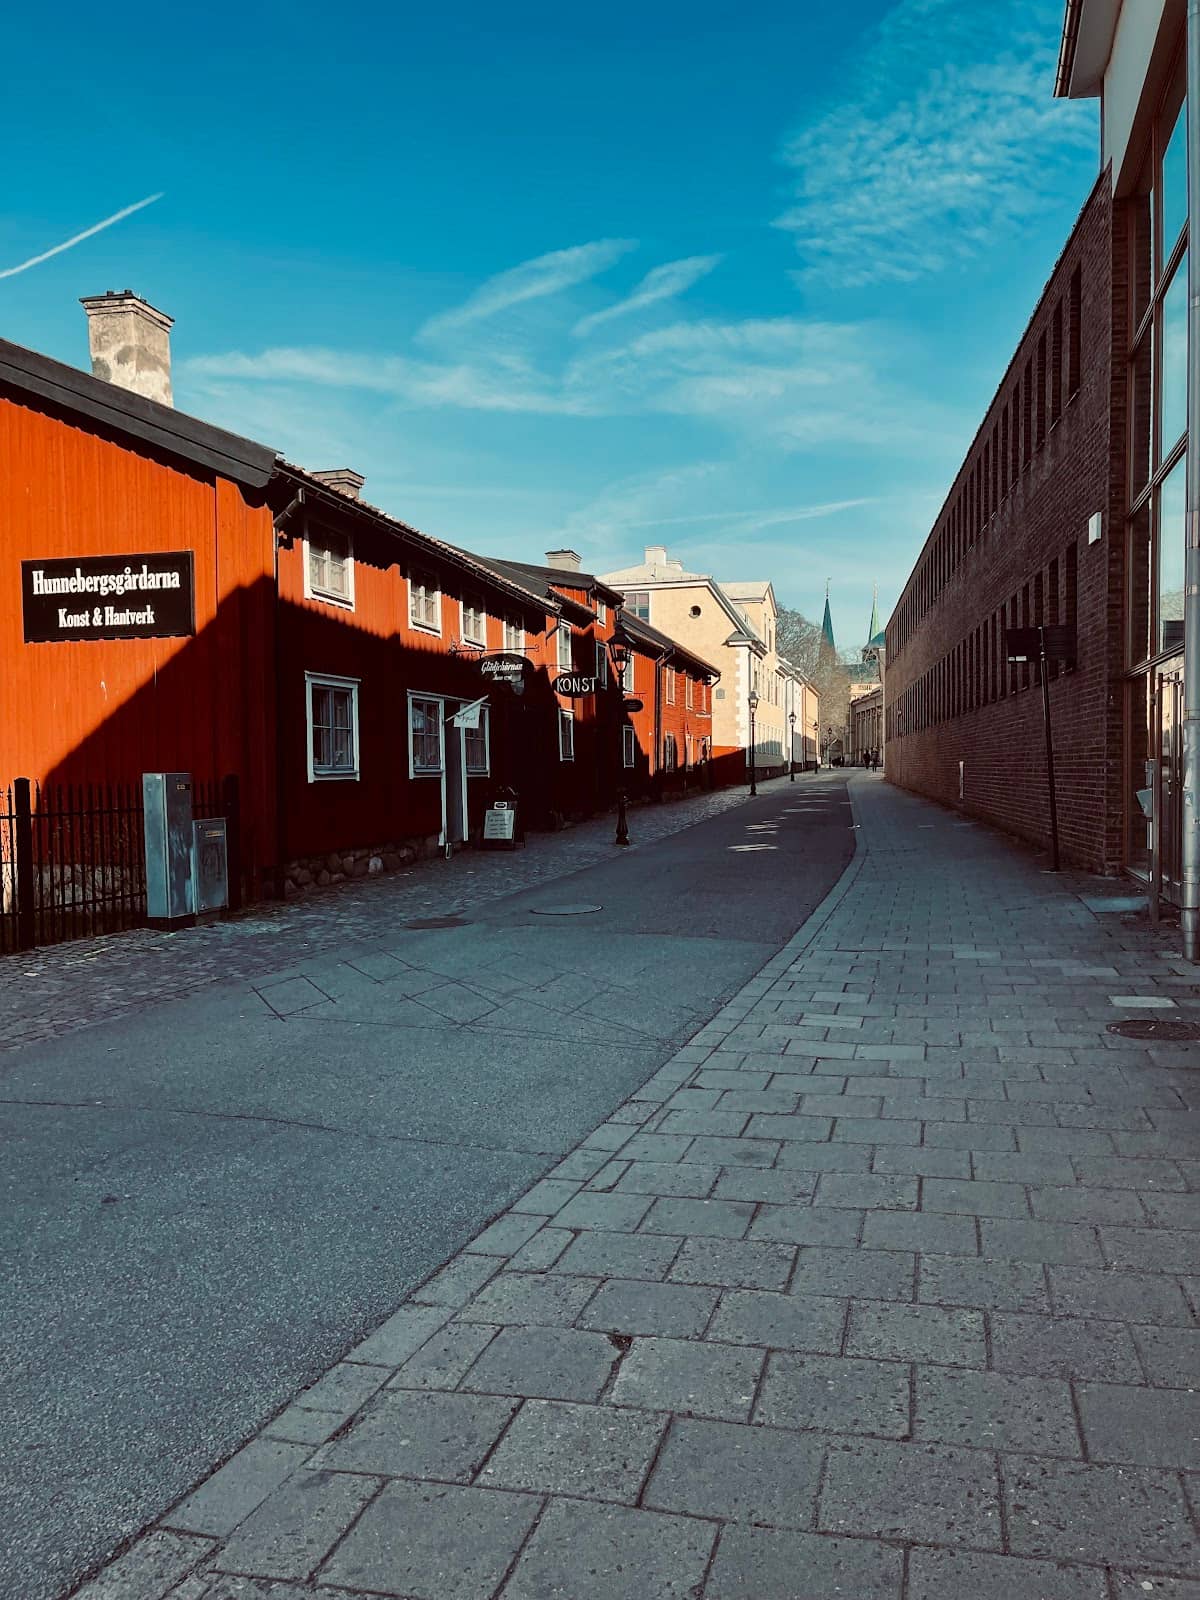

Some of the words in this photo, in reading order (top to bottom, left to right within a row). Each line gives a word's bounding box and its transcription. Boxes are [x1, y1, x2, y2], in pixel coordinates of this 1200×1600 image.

[32, 564, 180, 596] Hunnebergsgårdarna
[58, 608, 90, 628] Konst
[92, 606, 103, 626] &
[104, 604, 155, 626] Hantverk
[557, 677, 596, 693] KONST
